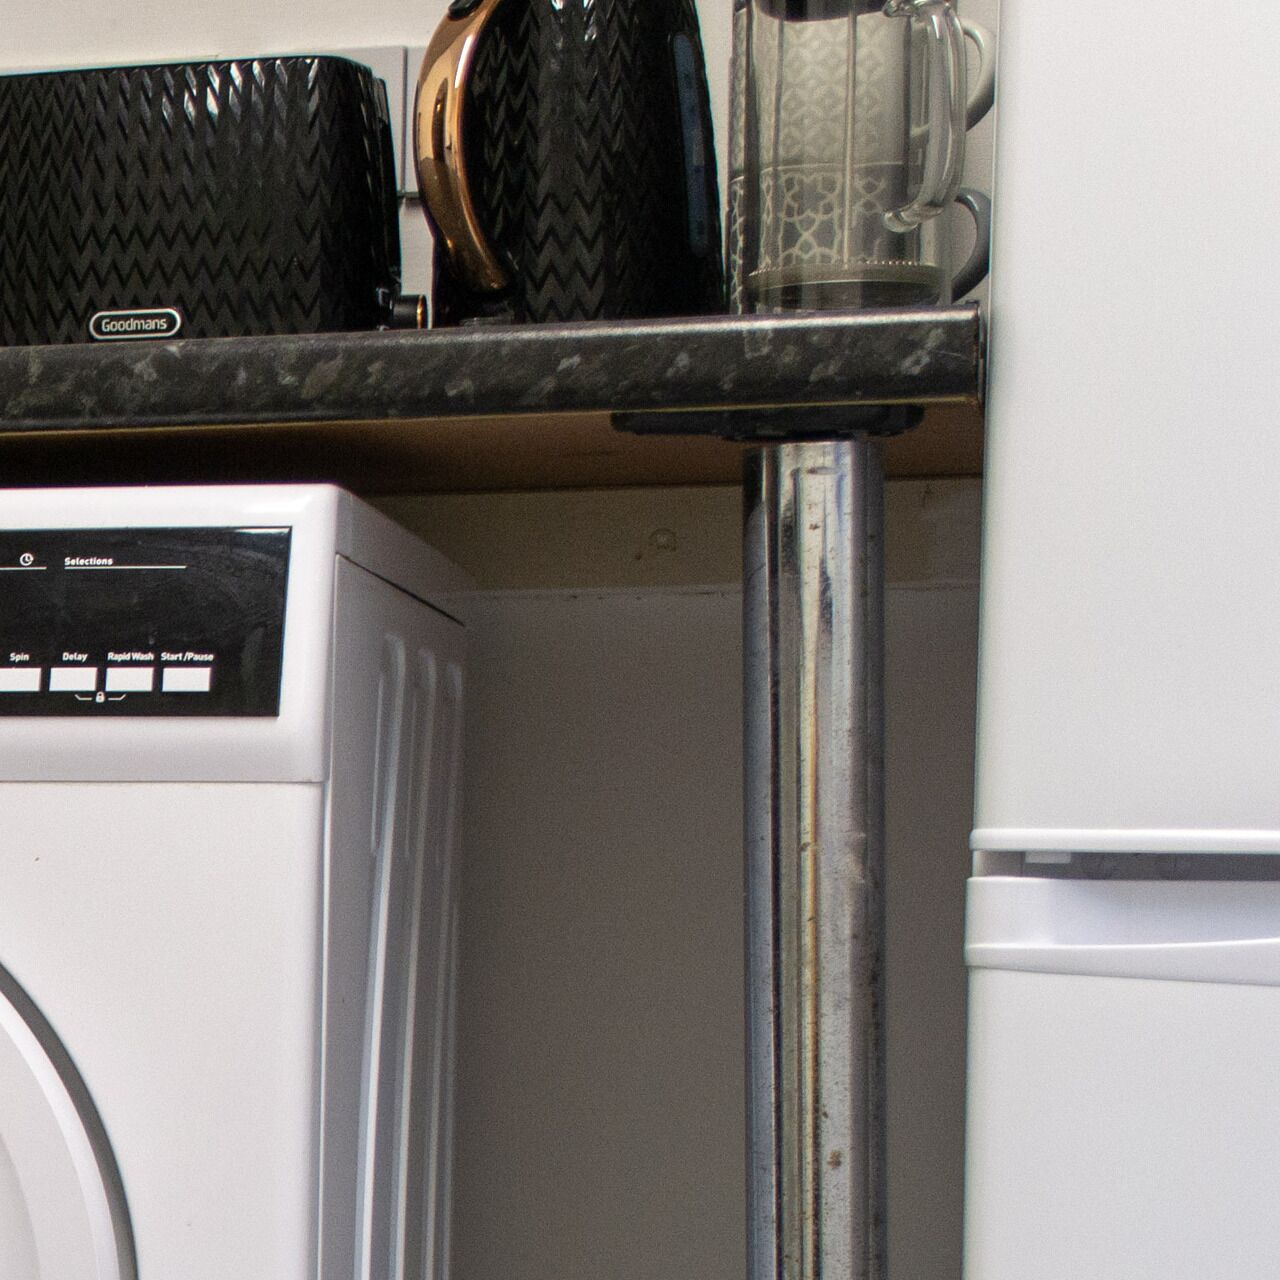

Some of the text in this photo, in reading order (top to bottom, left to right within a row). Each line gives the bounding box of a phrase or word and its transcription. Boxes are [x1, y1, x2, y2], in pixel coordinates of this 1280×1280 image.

[101, 318, 167, 332] Goodmans
[64, 557, 113, 566] Selections
[9, 652, 30, 662] Spin
[62, 652, 88, 662] Delay
[107, 652, 155, 662] Rapid Wash
